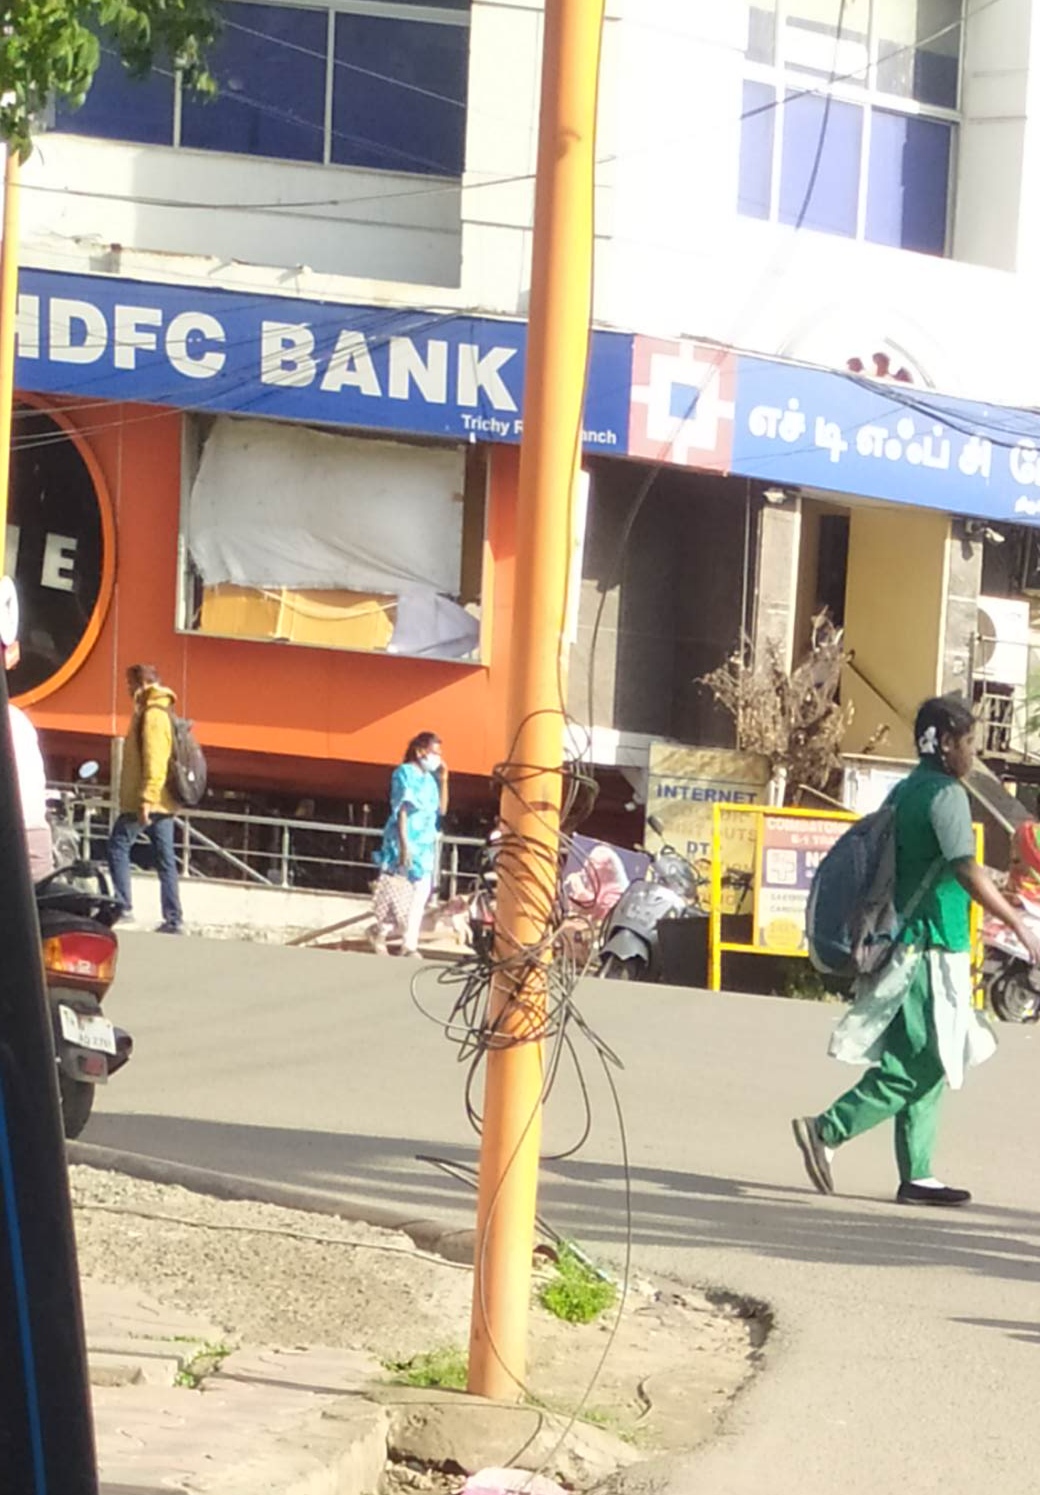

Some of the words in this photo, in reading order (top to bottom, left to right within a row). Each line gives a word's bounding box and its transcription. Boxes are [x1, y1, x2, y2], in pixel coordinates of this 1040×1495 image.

[259, 321, 519, 412] BANK
[461, 414, 510, 436] Trichy
[582, 428, 617, 446] anch
[747, 397, 807, 443] எச்
[814, 415, 848, 462] டி
[855, 417, 950, 470] எஃப்
[657, 785, 757, 803] INTERNET
[687, 841, 711, 855] DT
